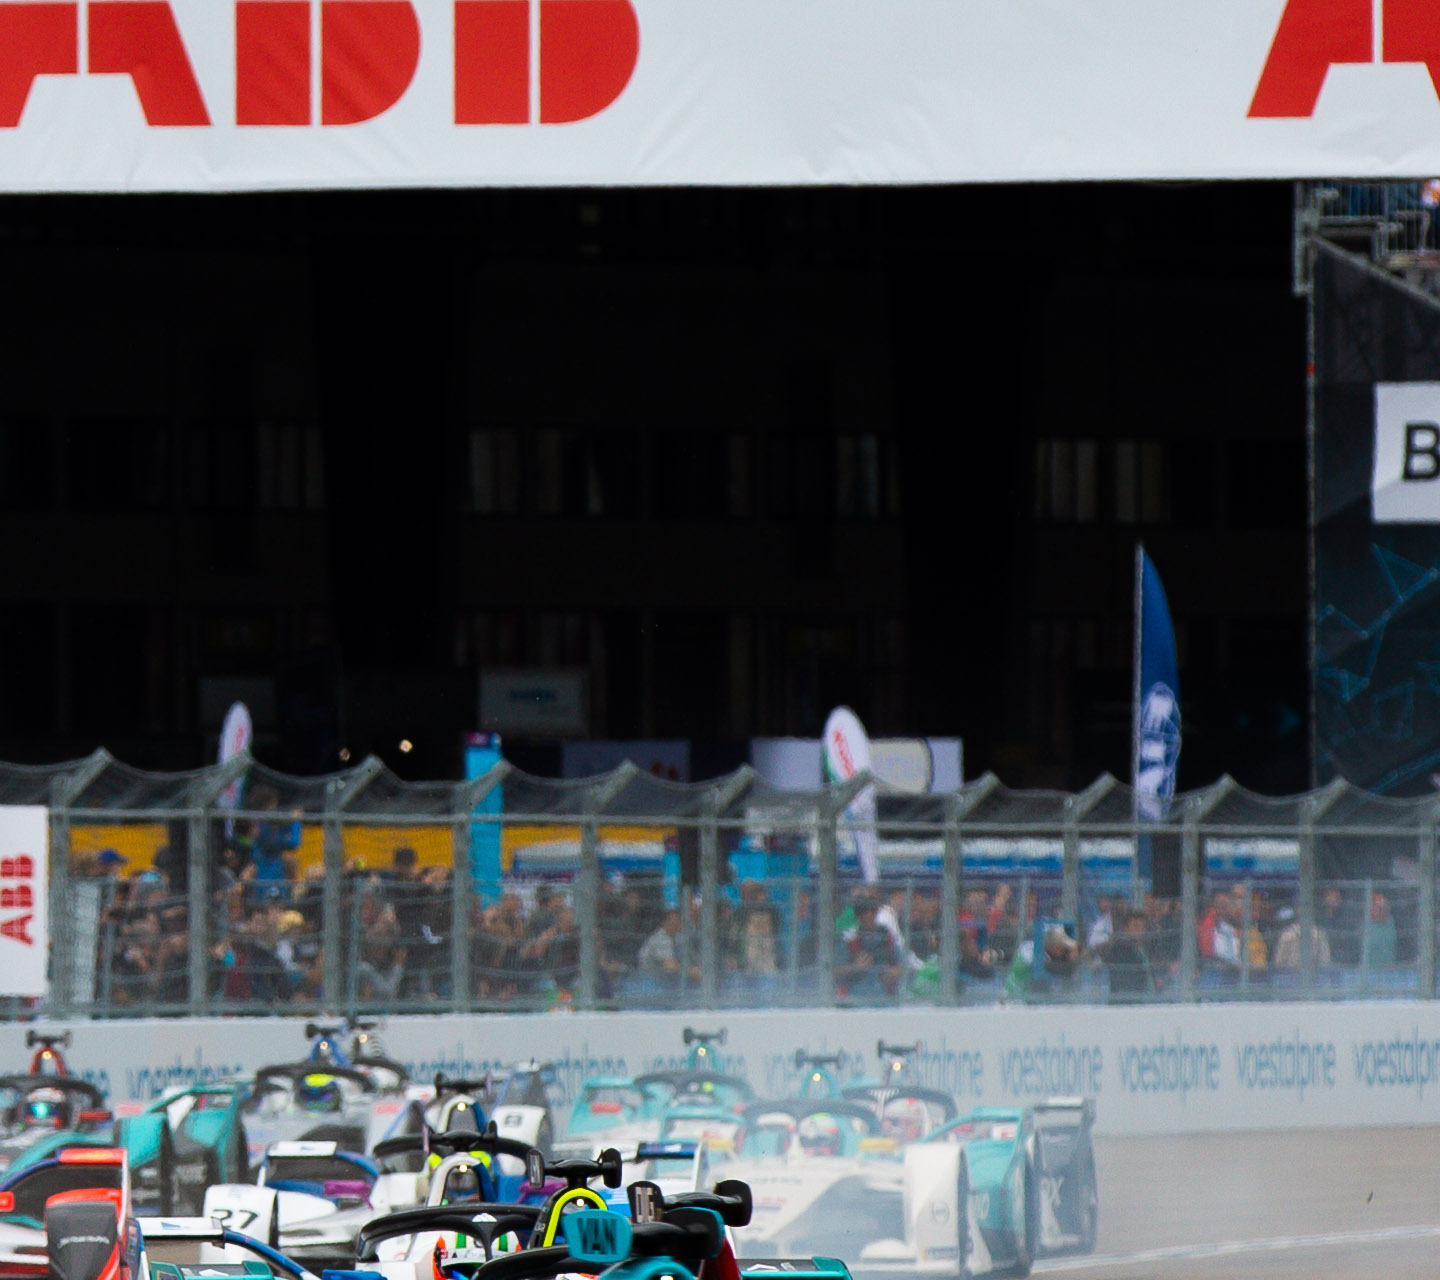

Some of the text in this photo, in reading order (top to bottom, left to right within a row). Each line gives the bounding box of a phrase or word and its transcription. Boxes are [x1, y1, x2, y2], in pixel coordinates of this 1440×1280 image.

[998, 1030, 1103, 1097] voestalpine
[1118, 1027, 1221, 1106] voestalpine
[1235, 1026, 1337, 1103] voestalpine
[211, 1209, 259, 1230] 27
[575, 1217, 618, 1256] VAN
